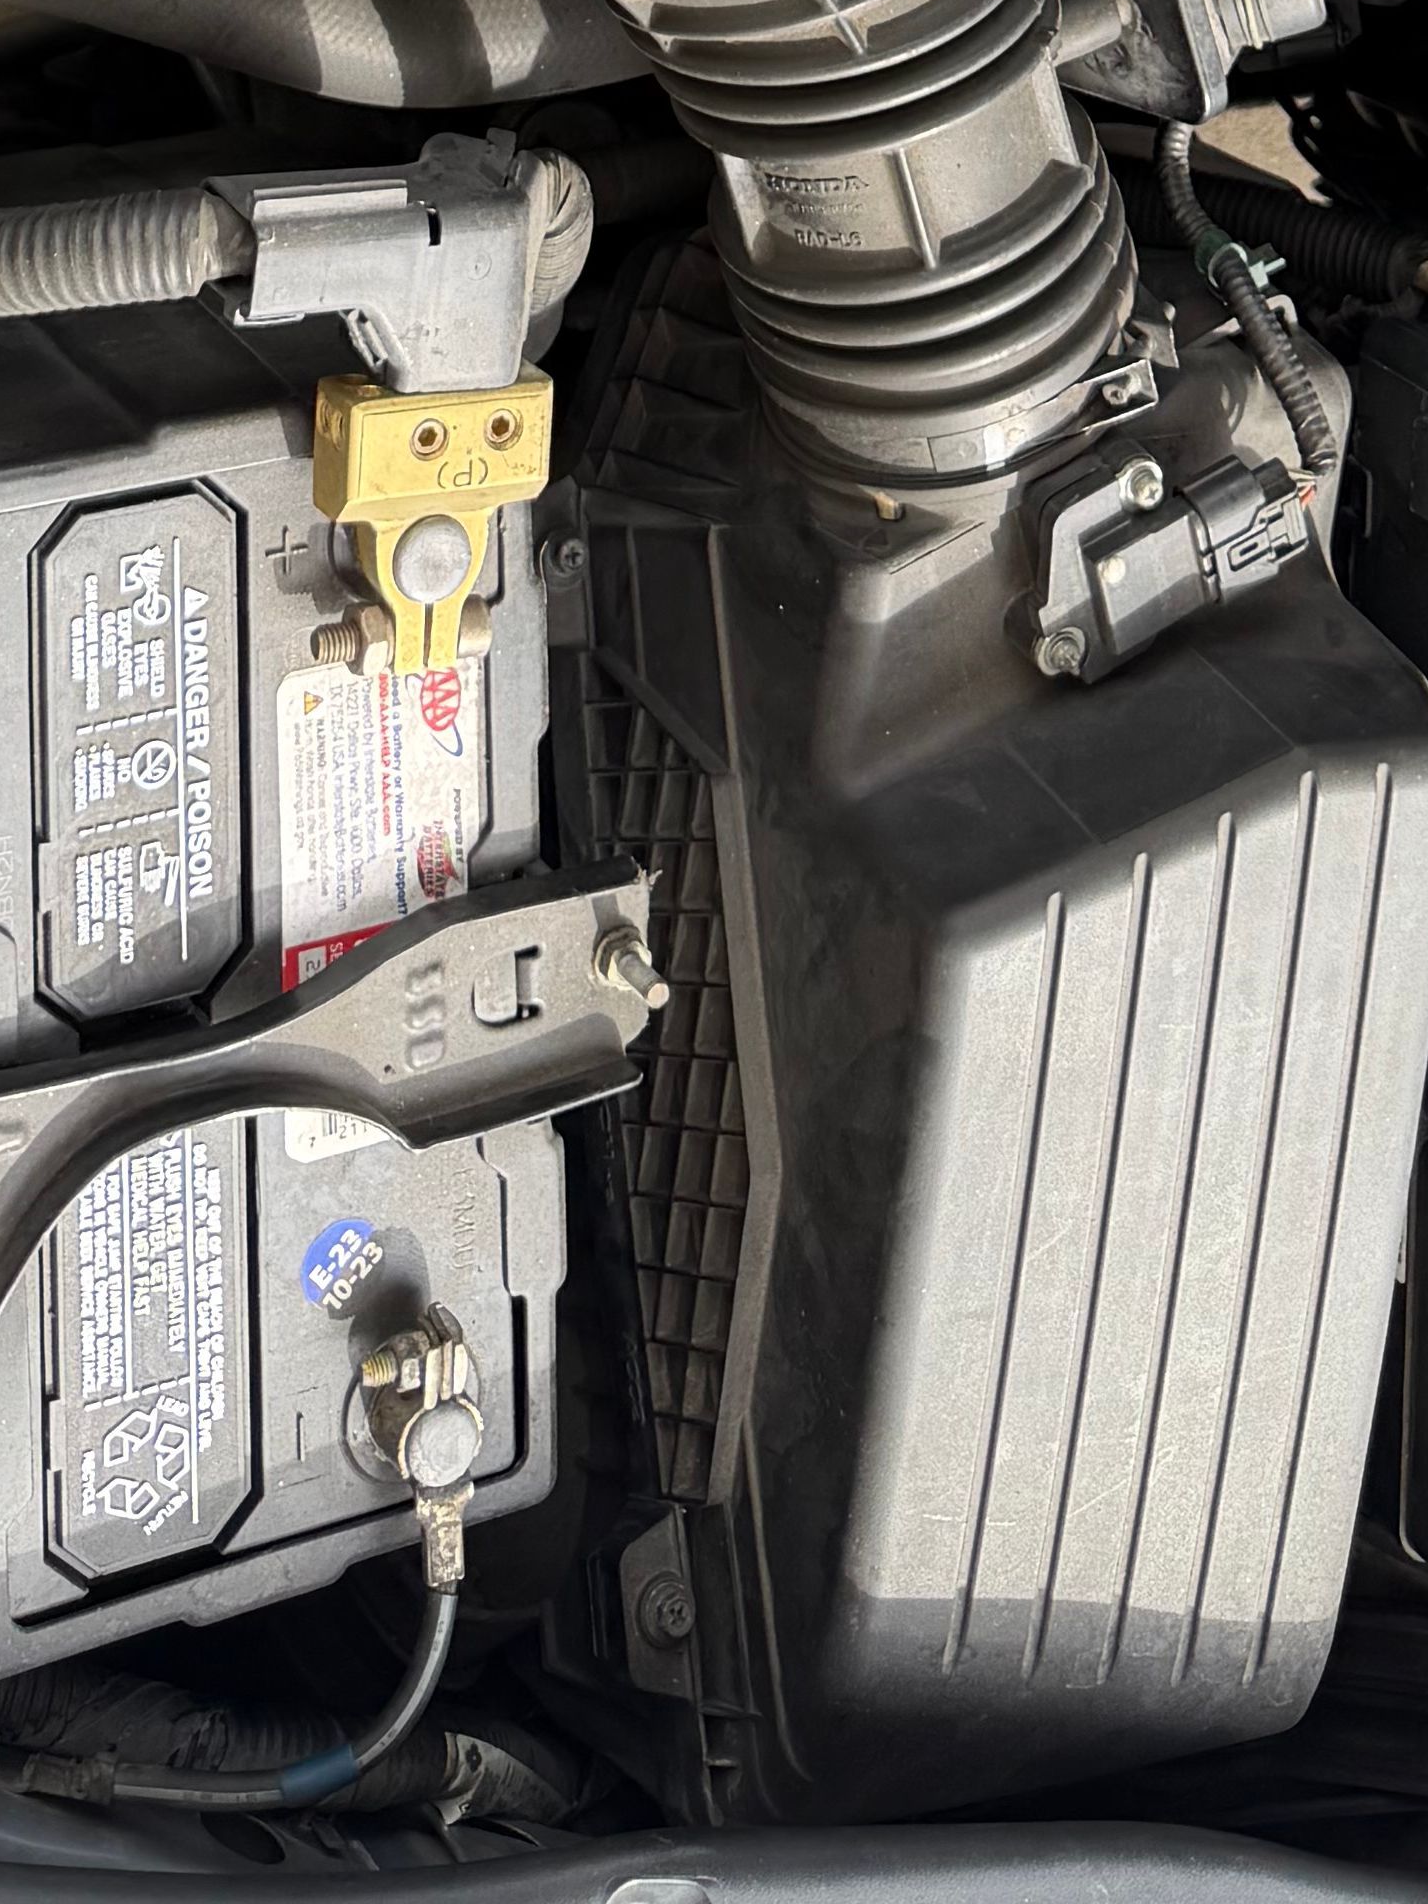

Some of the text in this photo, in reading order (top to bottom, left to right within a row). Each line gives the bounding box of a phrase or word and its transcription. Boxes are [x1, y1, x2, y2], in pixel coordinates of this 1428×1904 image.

[100, 611, 117, 669] GASES
[117, 607, 133, 700] EXPLOSIVE
[133, 642, 149, 687] EYES
[150, 638, 165, 698] SHIELD
[184, 618, 209, 752] DANGER
[421, 669, 460, 730] AAA
[116, 756, 132, 784] NO
[362, 732, 374, 746] by
[391, 724, 403, 772] Battery
[187, 779, 213, 899] POISON
[393, 791, 406, 853] Warranty
[117, 845, 134, 965] SULFURIC ACID
[395, 857, 408, 915] Support?
[130, 1155, 151, 1316] MEDICAL HELP FAST
[146, 1150, 168, 1294] WITH GET
[163, 1147, 186, 1354] FLUSH EYES IMMEDIATELY
[308, 1228, 362, 1291] E-23
[322, 1241, 384, 1311] 10-23
[81, 1448, 96, 1516] RECYCLE
